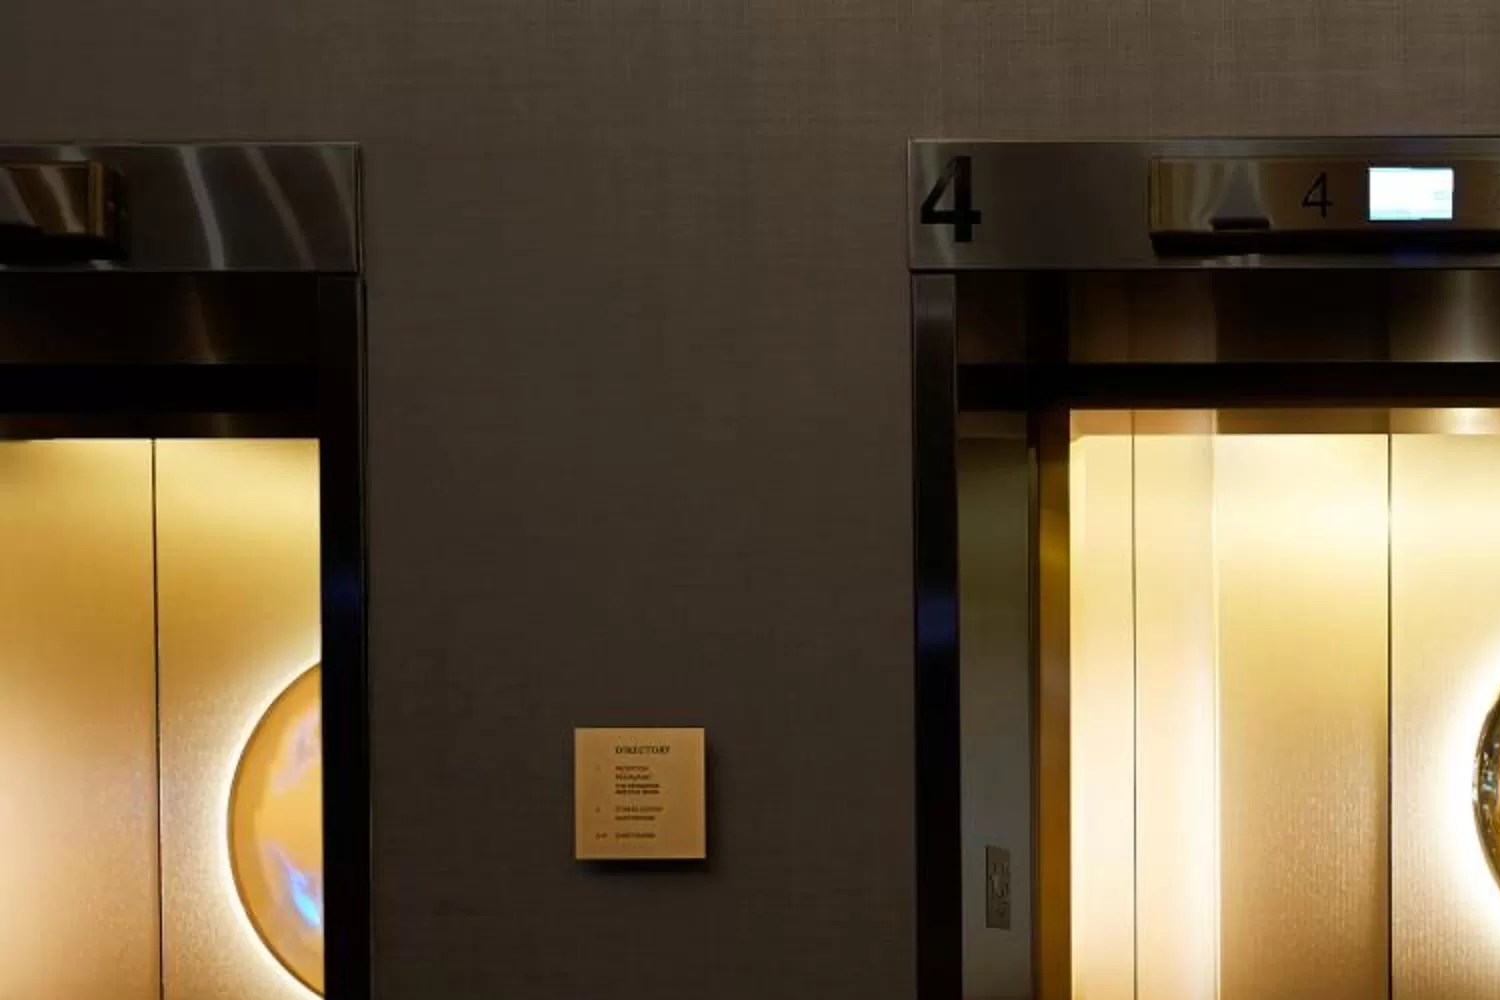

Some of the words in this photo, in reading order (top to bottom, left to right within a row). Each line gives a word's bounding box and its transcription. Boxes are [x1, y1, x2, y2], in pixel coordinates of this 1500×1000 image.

[920, 155, 982, 243] 4
[1302, 171, 1333, 218] 4
[615, 745, 671, 755] DIRECTORY
